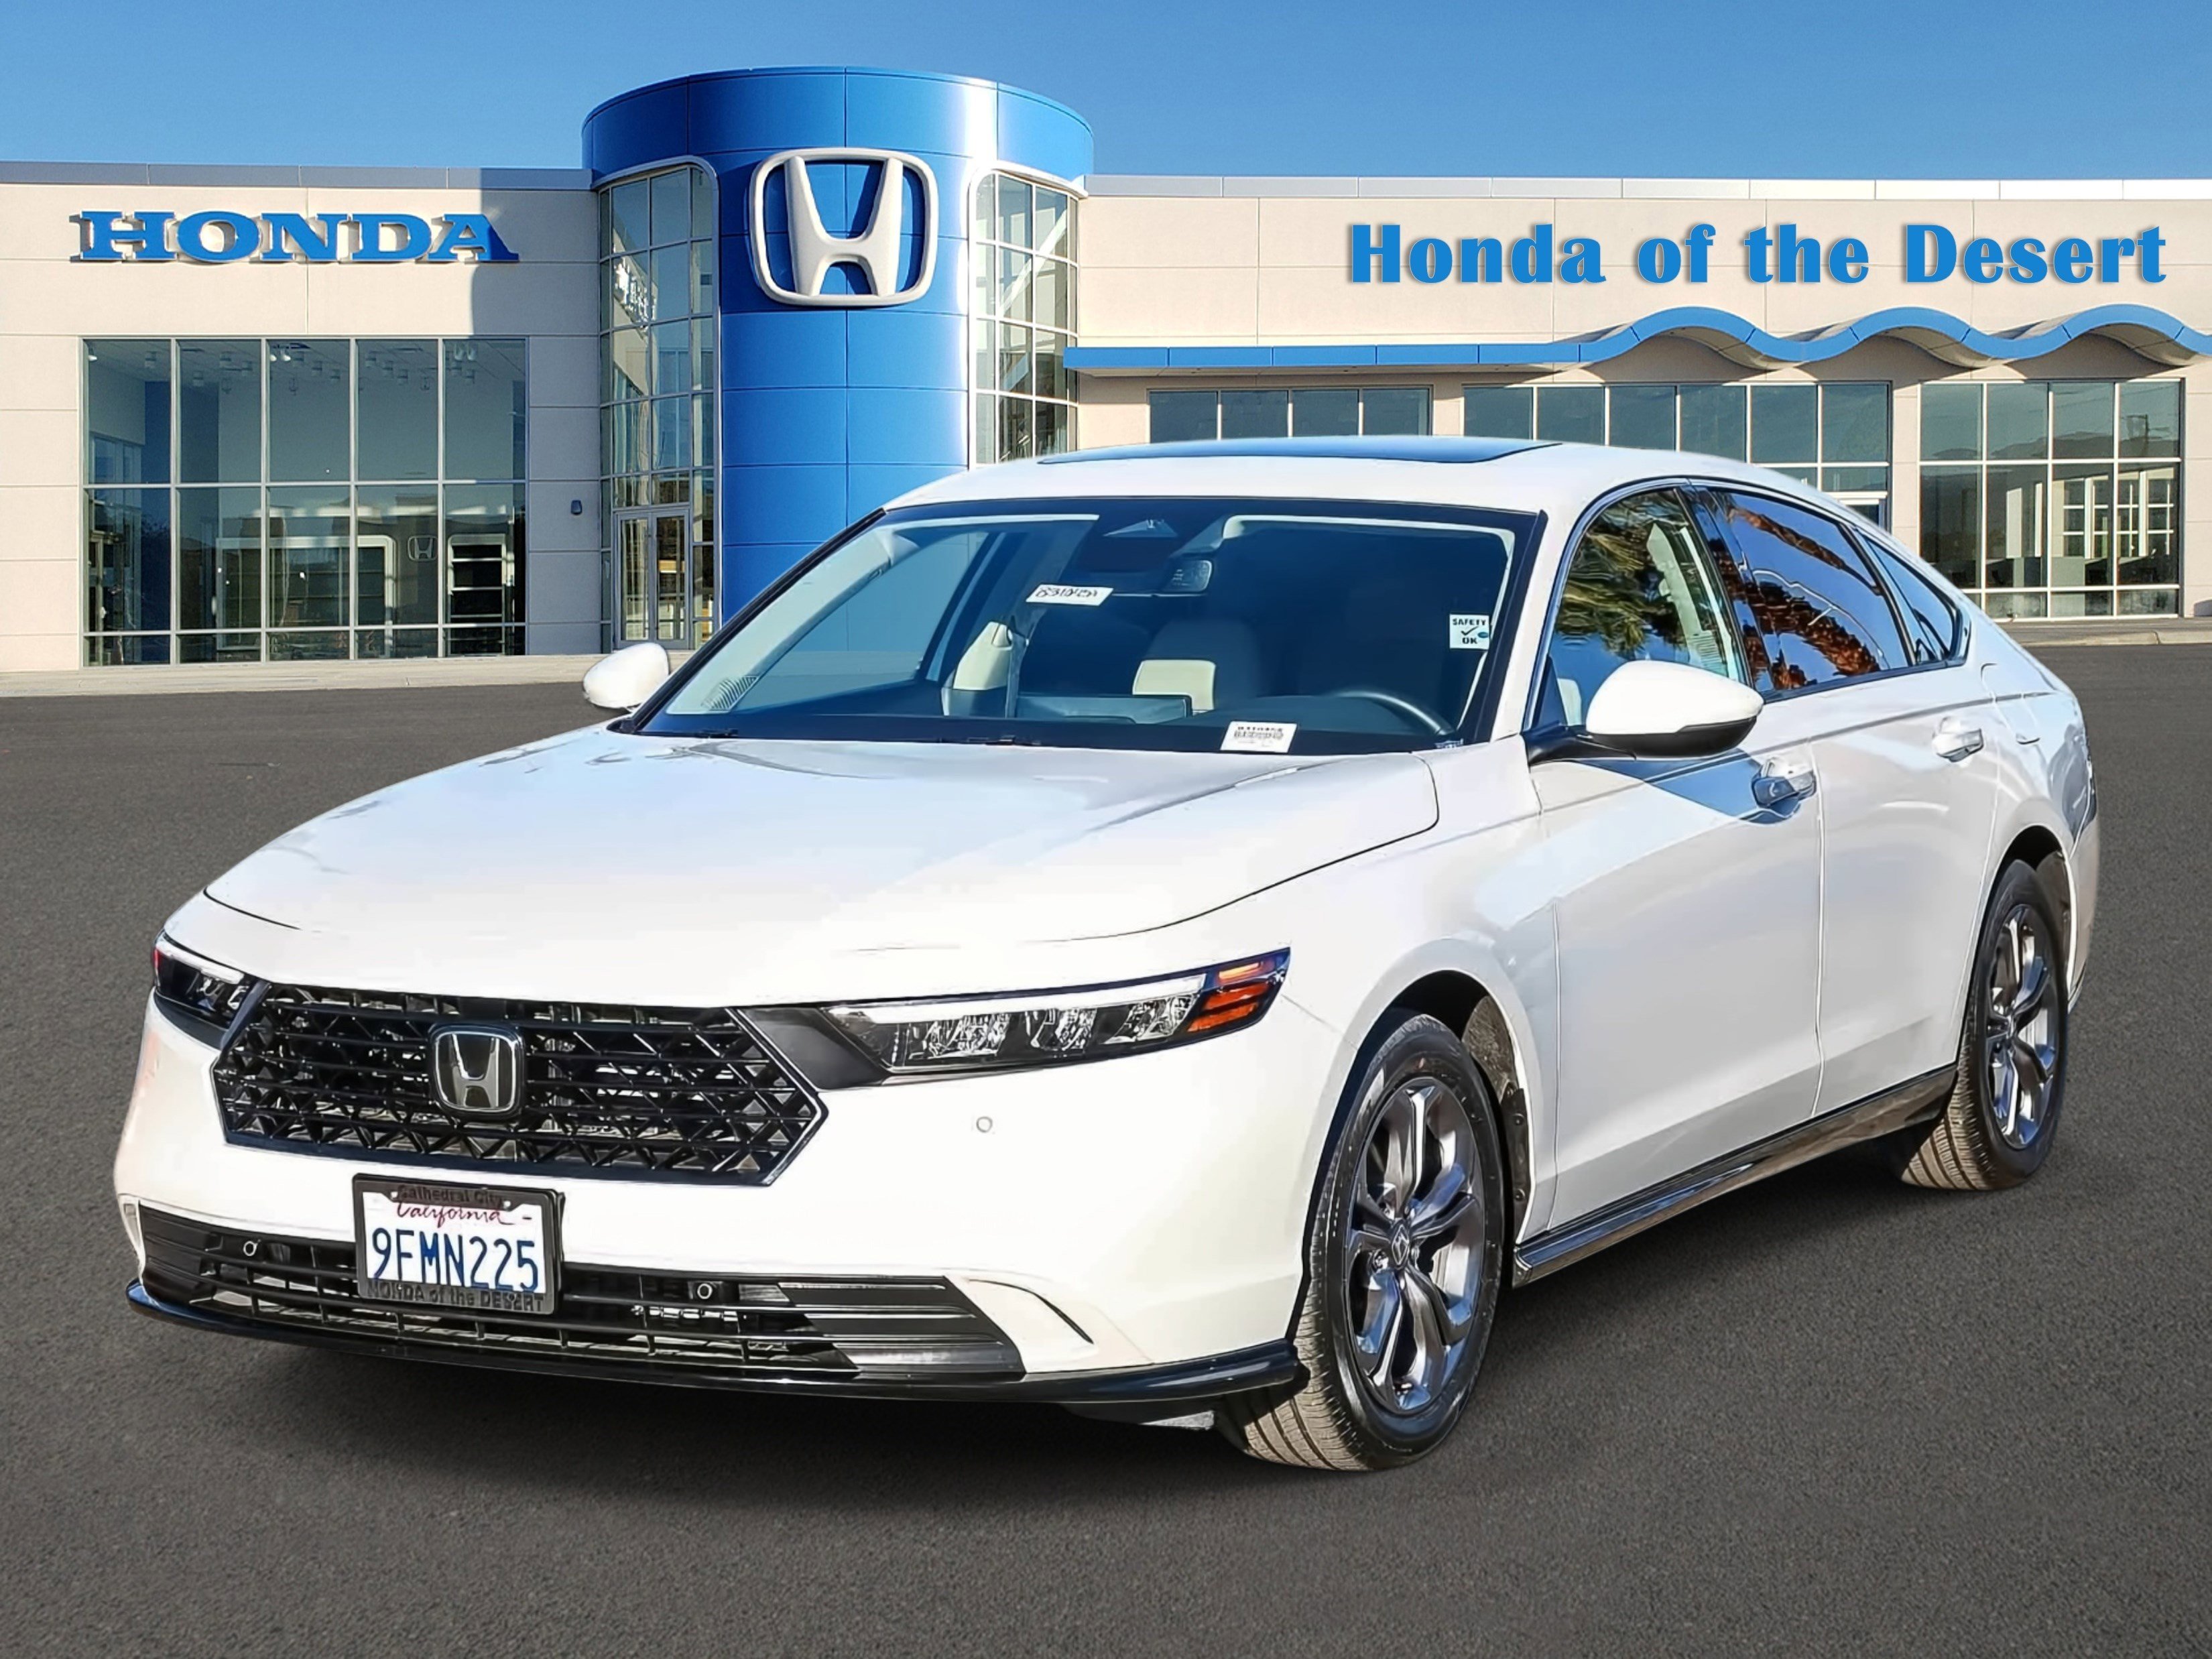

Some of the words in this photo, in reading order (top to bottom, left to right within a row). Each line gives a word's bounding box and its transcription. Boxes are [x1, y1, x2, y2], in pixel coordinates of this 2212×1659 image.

[81, 210, 519, 262] HONDA
[1349, 223, 1607, 284] Honda
[1637, 223, 1717, 284] of
[1743, 223, 1869, 284] the
[1905, 224, 2167, 284] Desert
[397, 1184, 469, 1203] Cathedral
[474, 1190, 503, 1207] City
[372, 1227, 538, 1292] 9FMN225
